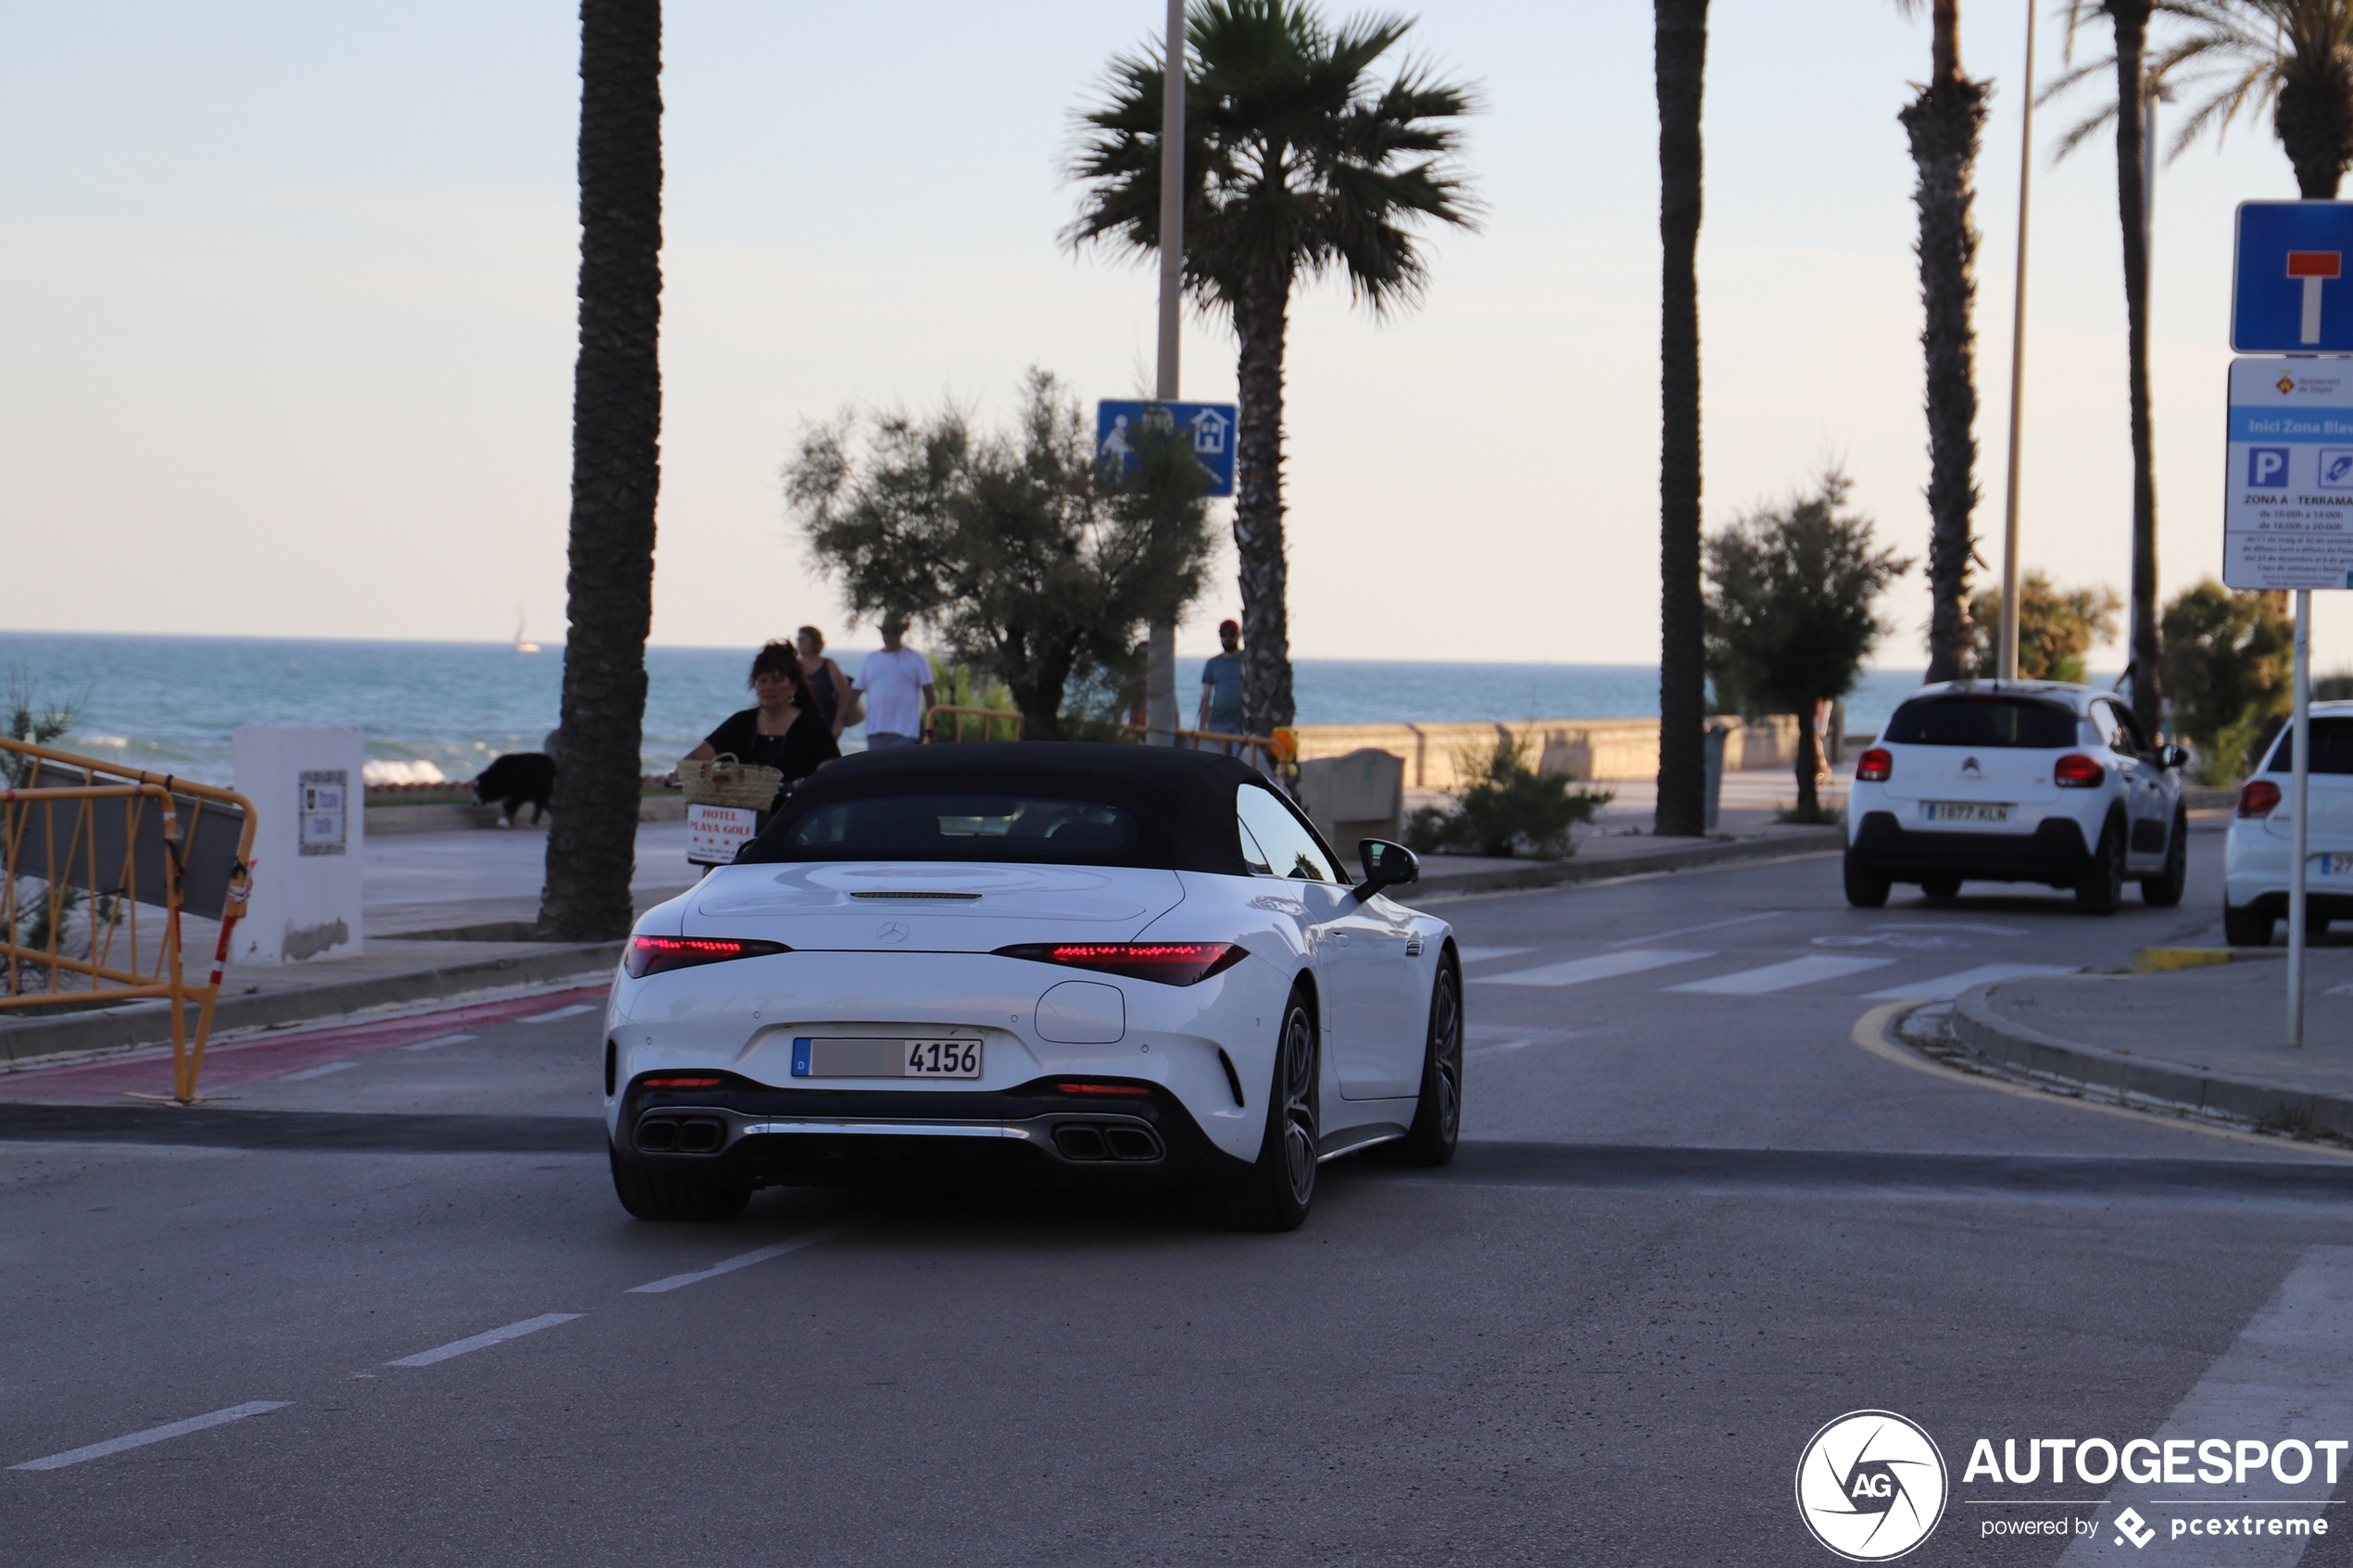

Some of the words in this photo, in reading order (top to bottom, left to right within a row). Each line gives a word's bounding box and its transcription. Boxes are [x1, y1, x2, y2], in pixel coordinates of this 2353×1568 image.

[2249, 419, 2280, 433] Inici
[2284, 420, 2321, 433] Zona
[2245, 495, 2278, 505] ZONA
[2280, 495, 2288, 505] A
[702, 809, 737, 822] HOTEL
[1939, 805, 1975, 820] 1877
[1979, 807, 2007, 821] KLN
[689, 821, 720, 833] PLAYA
[724, 825, 752, 835] GOLF
[798, 1061, 805, 1070] D
[910, 1043, 976, 1073] 4156
